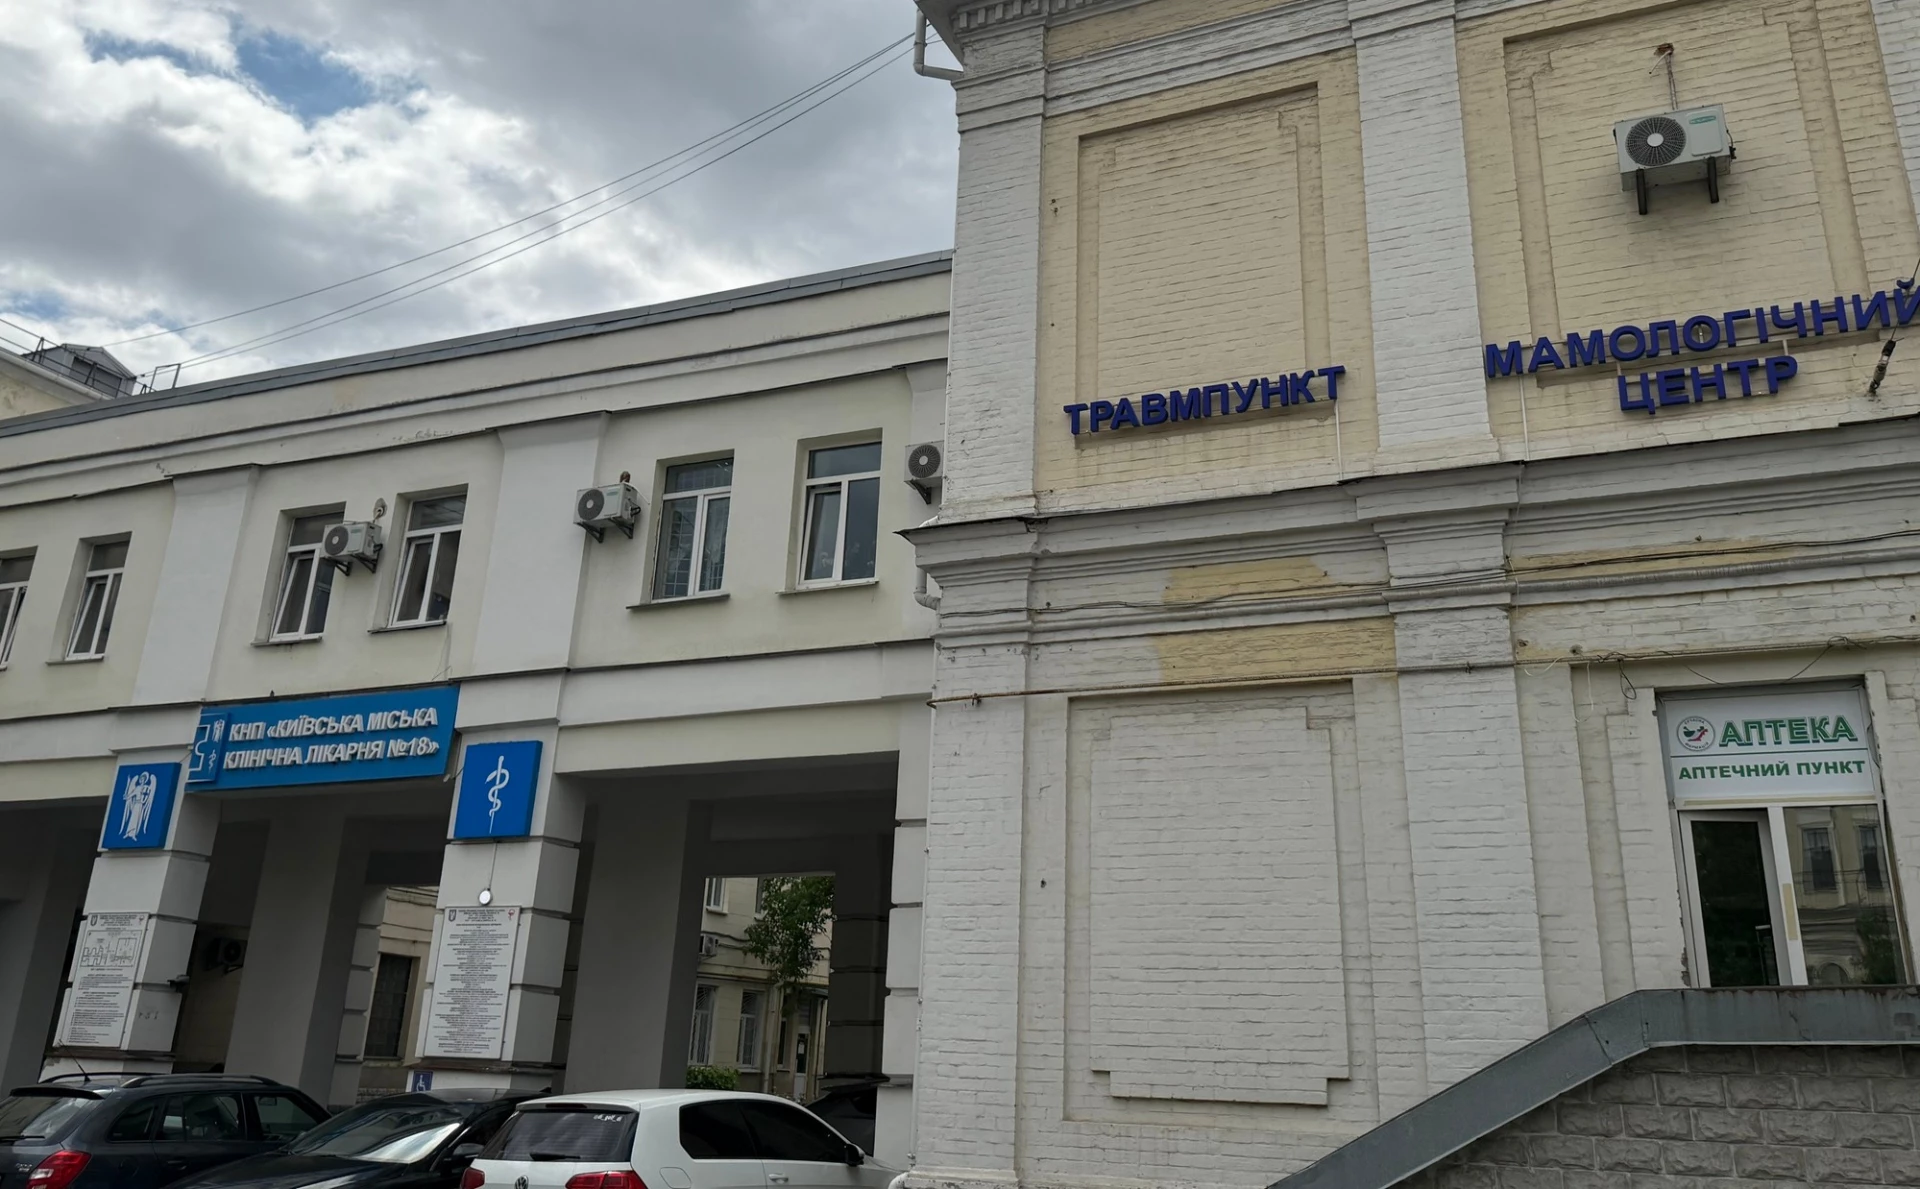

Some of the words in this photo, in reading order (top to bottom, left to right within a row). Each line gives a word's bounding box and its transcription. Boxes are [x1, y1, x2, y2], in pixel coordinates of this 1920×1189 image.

[1486, 278, 1920, 378] МАМОЛОГІЧНИЙ
[1063, 366, 1346, 435] ТРАВМПУНКТ
[1618, 355, 1798, 414] ЦЕНТР
[229, 721, 265, 742] КНП
[267, 713, 363, 738] «КИЇВСЬКА
[366, 707, 438, 731] МІСЬКА
[1719, 715, 1858, 747] АПТЕКА
[223, 748, 301, 770] КЛІНІЧНА
[304, 739, 385, 765] ЛІКАРНЯ
[1678, 760, 1790, 780] АПТЕЧНИЙ
[1796, 760, 1866, 776] ПУНКТ
